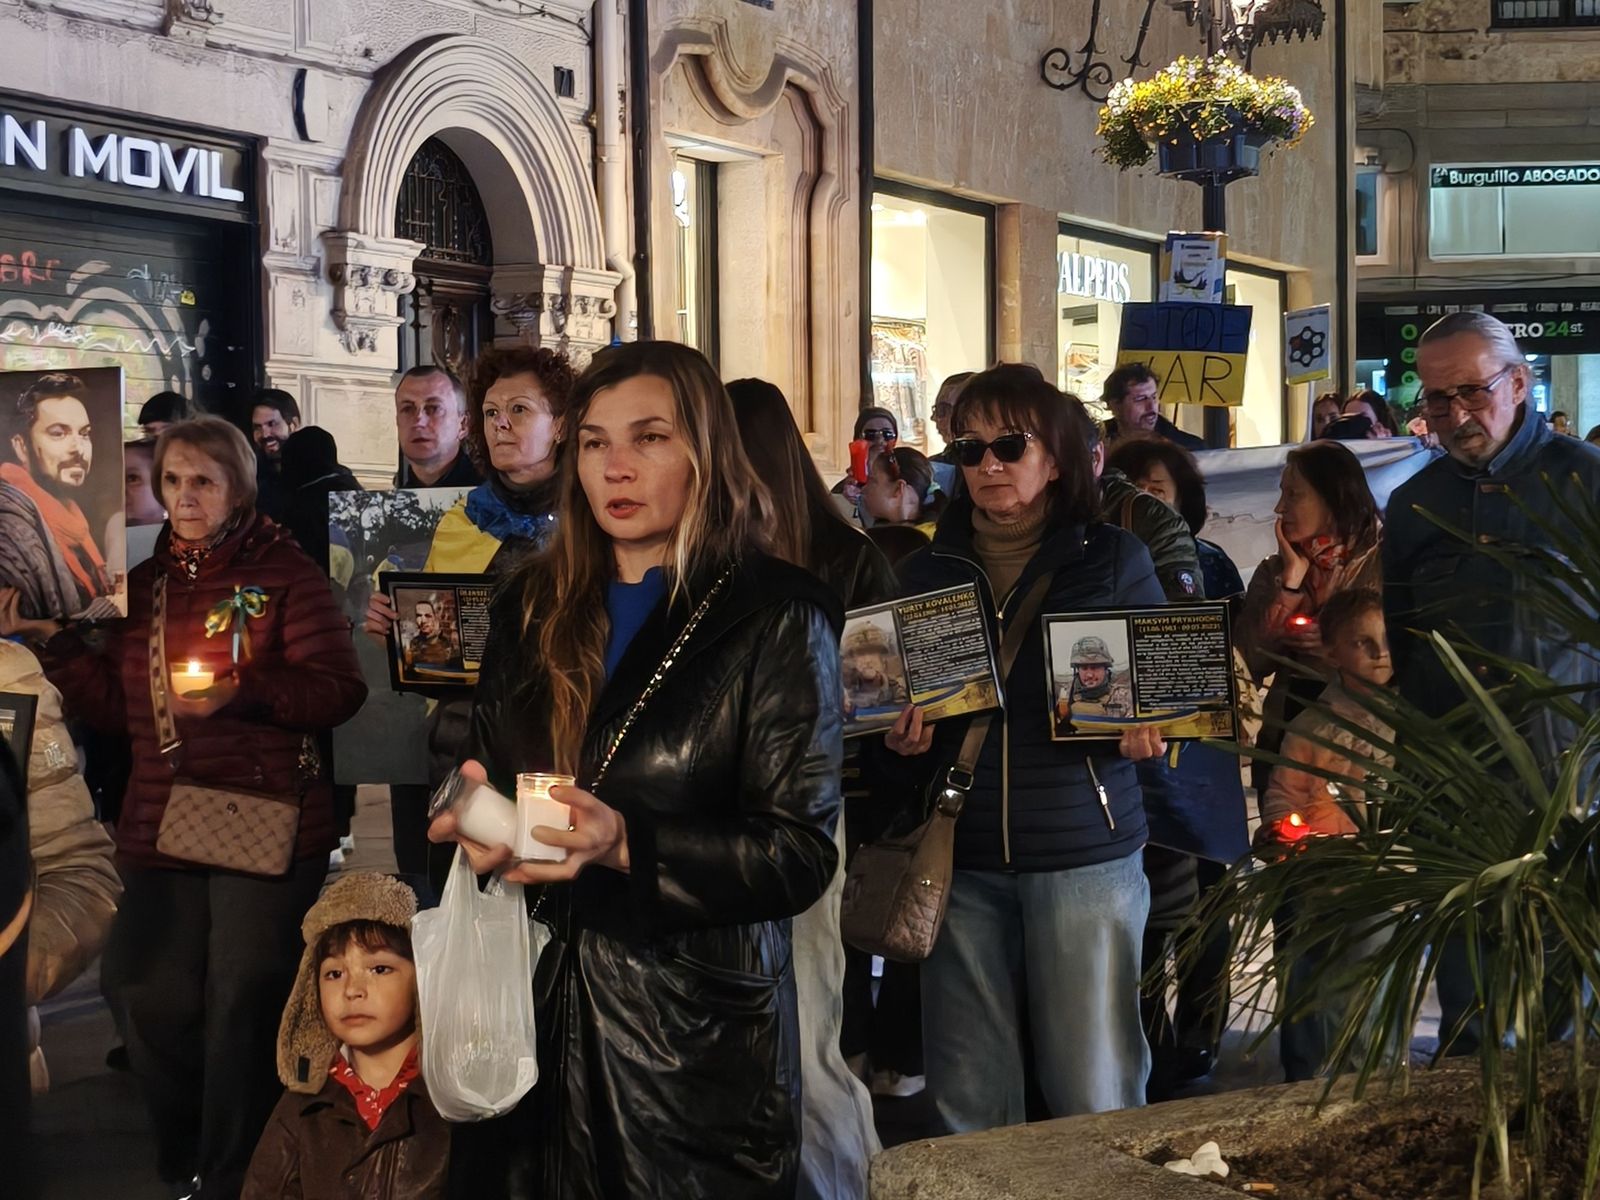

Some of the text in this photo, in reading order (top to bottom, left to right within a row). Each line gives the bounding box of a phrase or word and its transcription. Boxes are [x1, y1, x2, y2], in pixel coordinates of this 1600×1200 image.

[73, 127, 245, 203] MOVIL
[1449, 169, 1520, 186] Burguillo
[1057, 251, 1131, 304] ALPERS
[1128, 306, 1249, 352] STOP
[1147, 353, 1233, 403] AR
